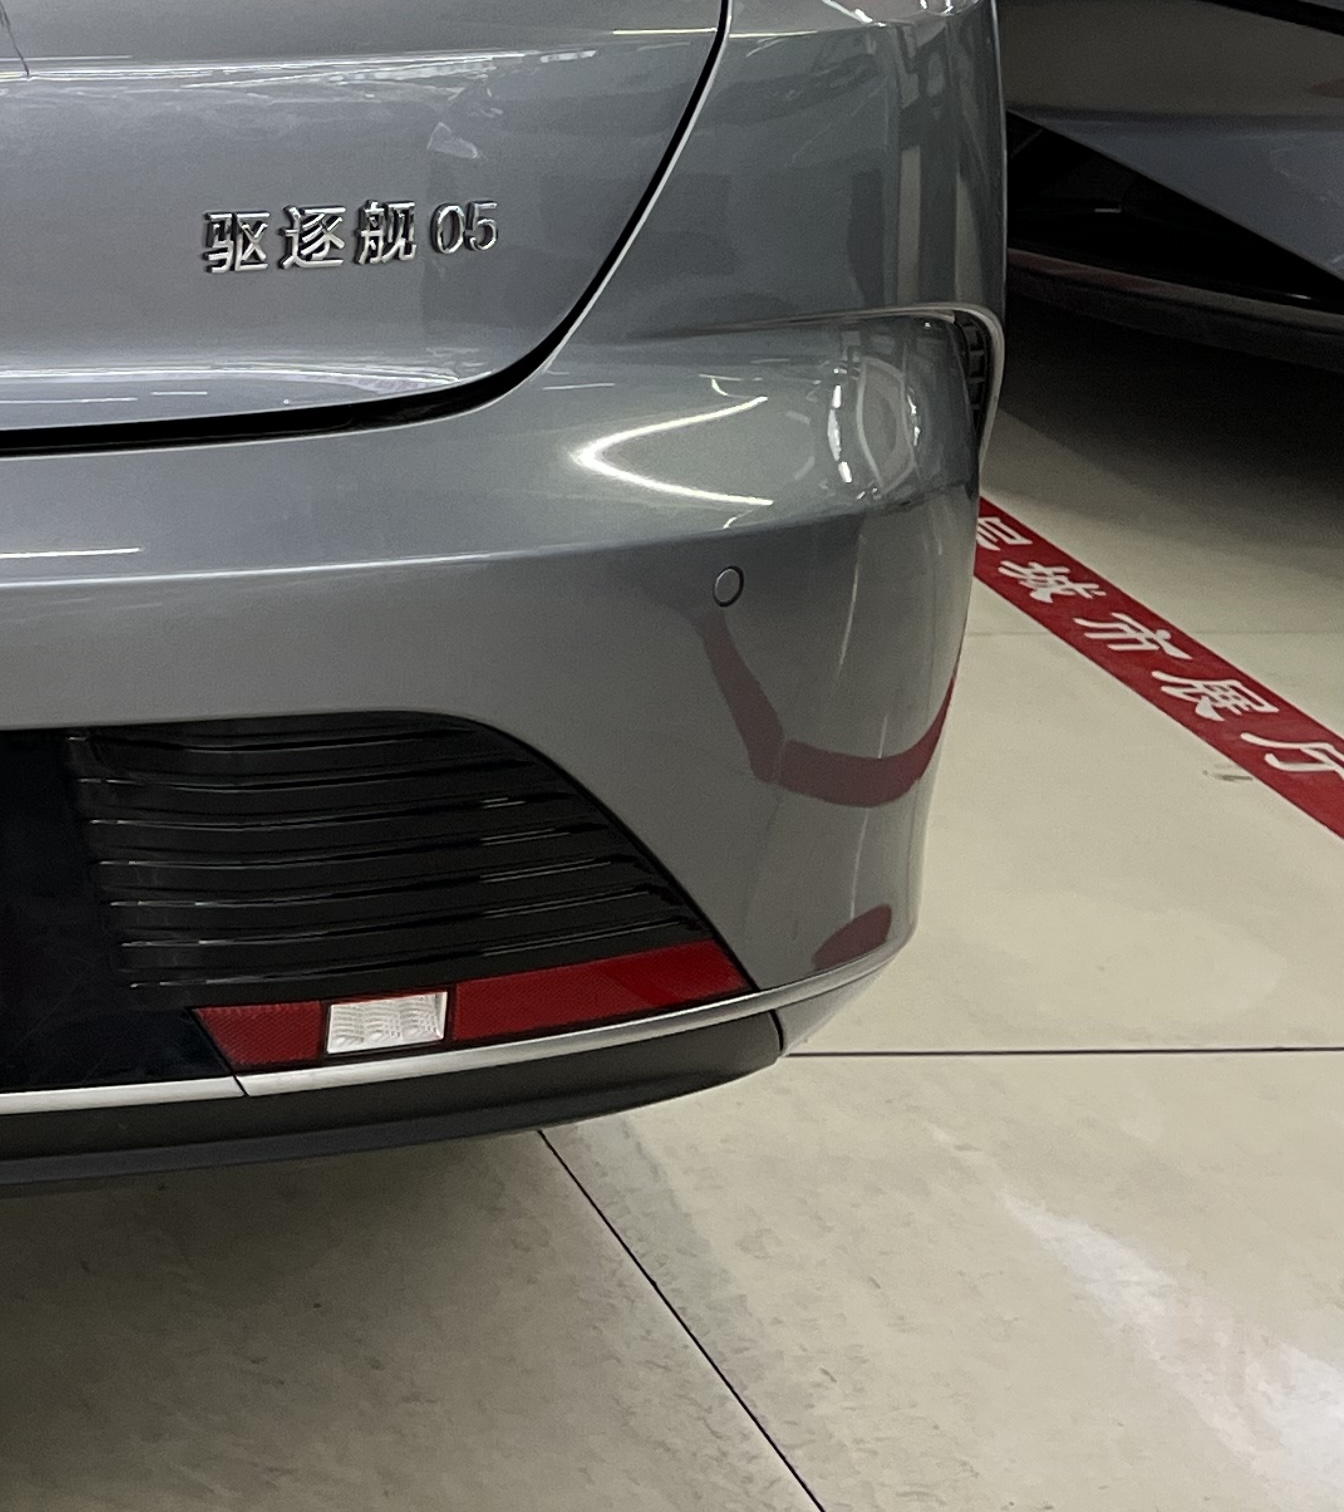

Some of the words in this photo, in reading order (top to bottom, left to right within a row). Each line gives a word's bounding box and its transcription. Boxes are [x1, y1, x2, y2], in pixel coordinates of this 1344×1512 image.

[203, 199, 417, 273] 驱逐舰
[429, 201, 498, 255] 05
